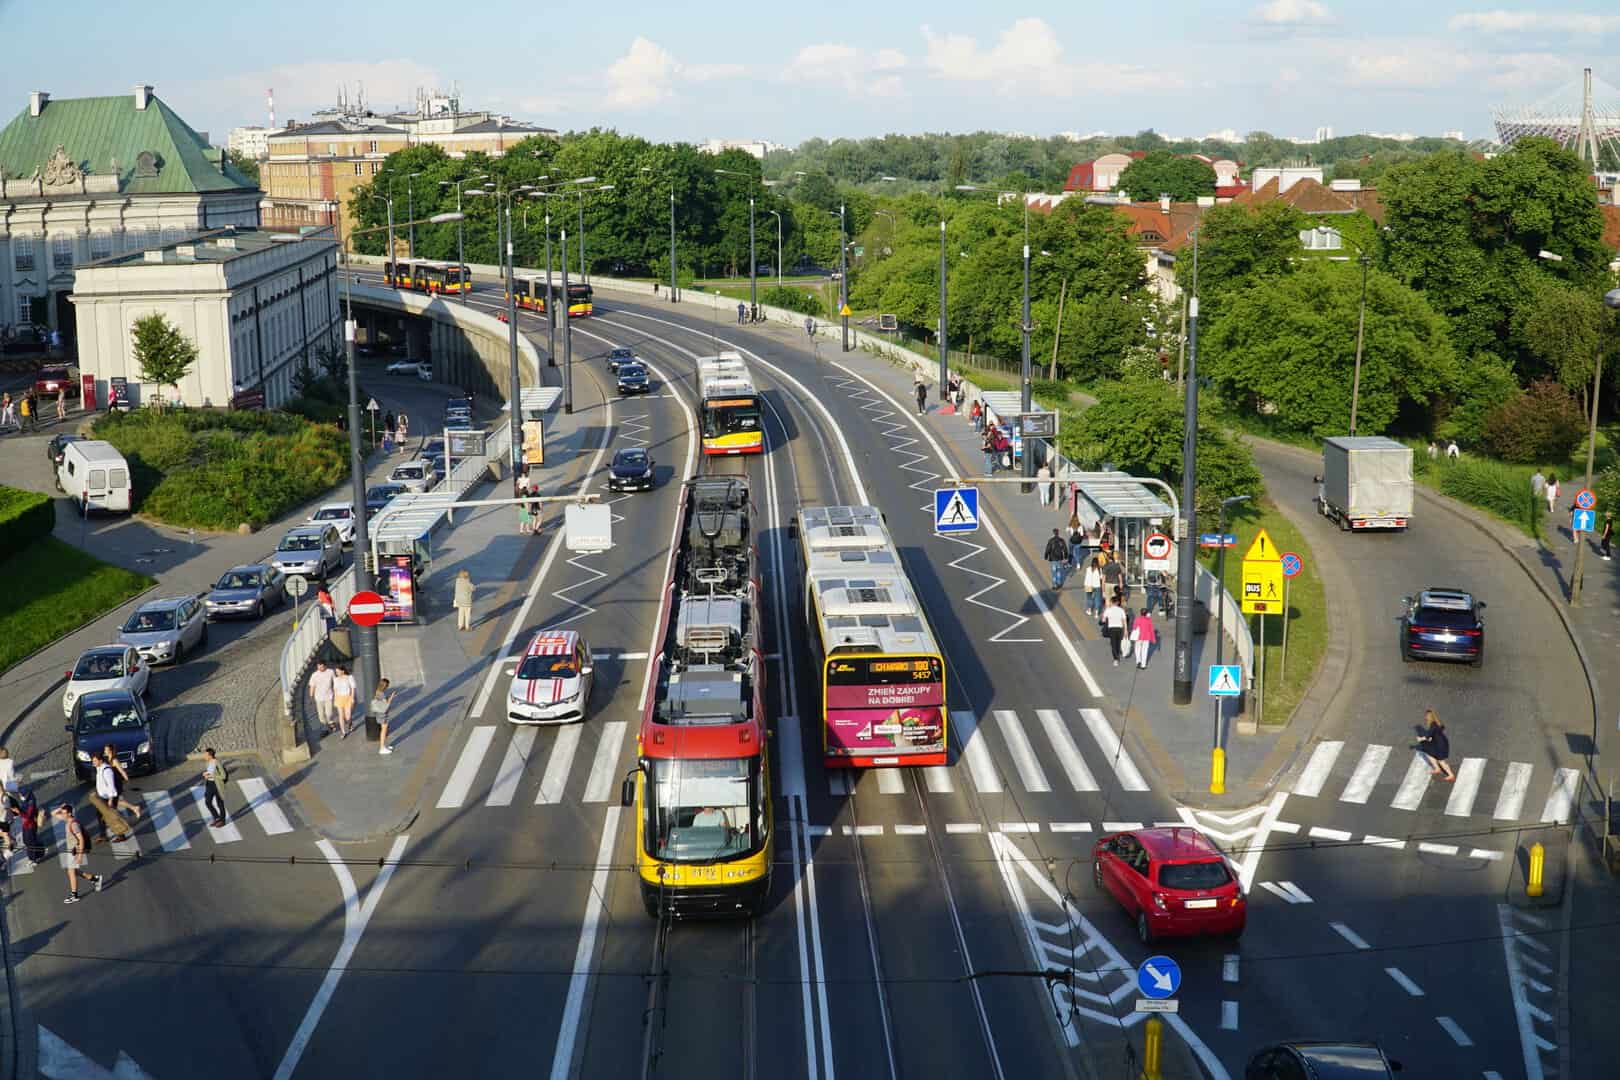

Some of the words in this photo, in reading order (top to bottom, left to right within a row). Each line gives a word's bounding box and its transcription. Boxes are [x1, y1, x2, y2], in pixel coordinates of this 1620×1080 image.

[1246, 584, 1260, 592] BUS
[897, 686, 931, 695] ZAKUPY
[868, 697, 881, 705] NA
